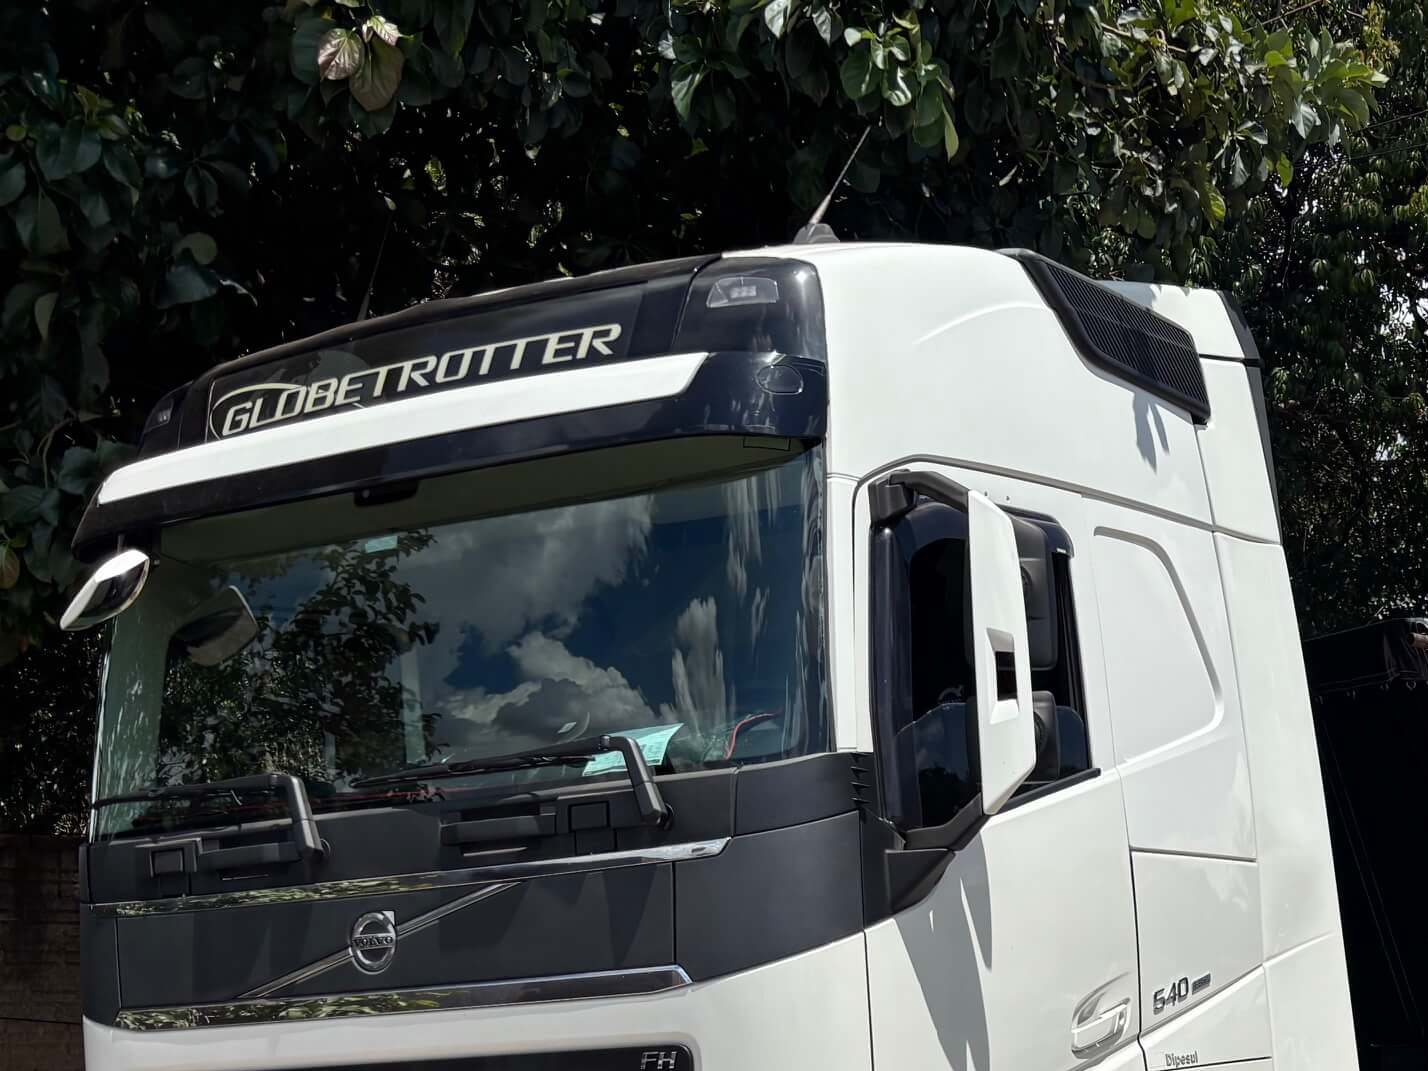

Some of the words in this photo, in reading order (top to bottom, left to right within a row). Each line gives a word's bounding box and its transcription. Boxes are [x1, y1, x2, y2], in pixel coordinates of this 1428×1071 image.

[222, 323, 622, 437] GLOBETROTTER
[1153, 976, 1189, 1014] 540
[640, 1051, 677, 1069] FH
[1165, 1050, 1198, 1068] Dipesul
